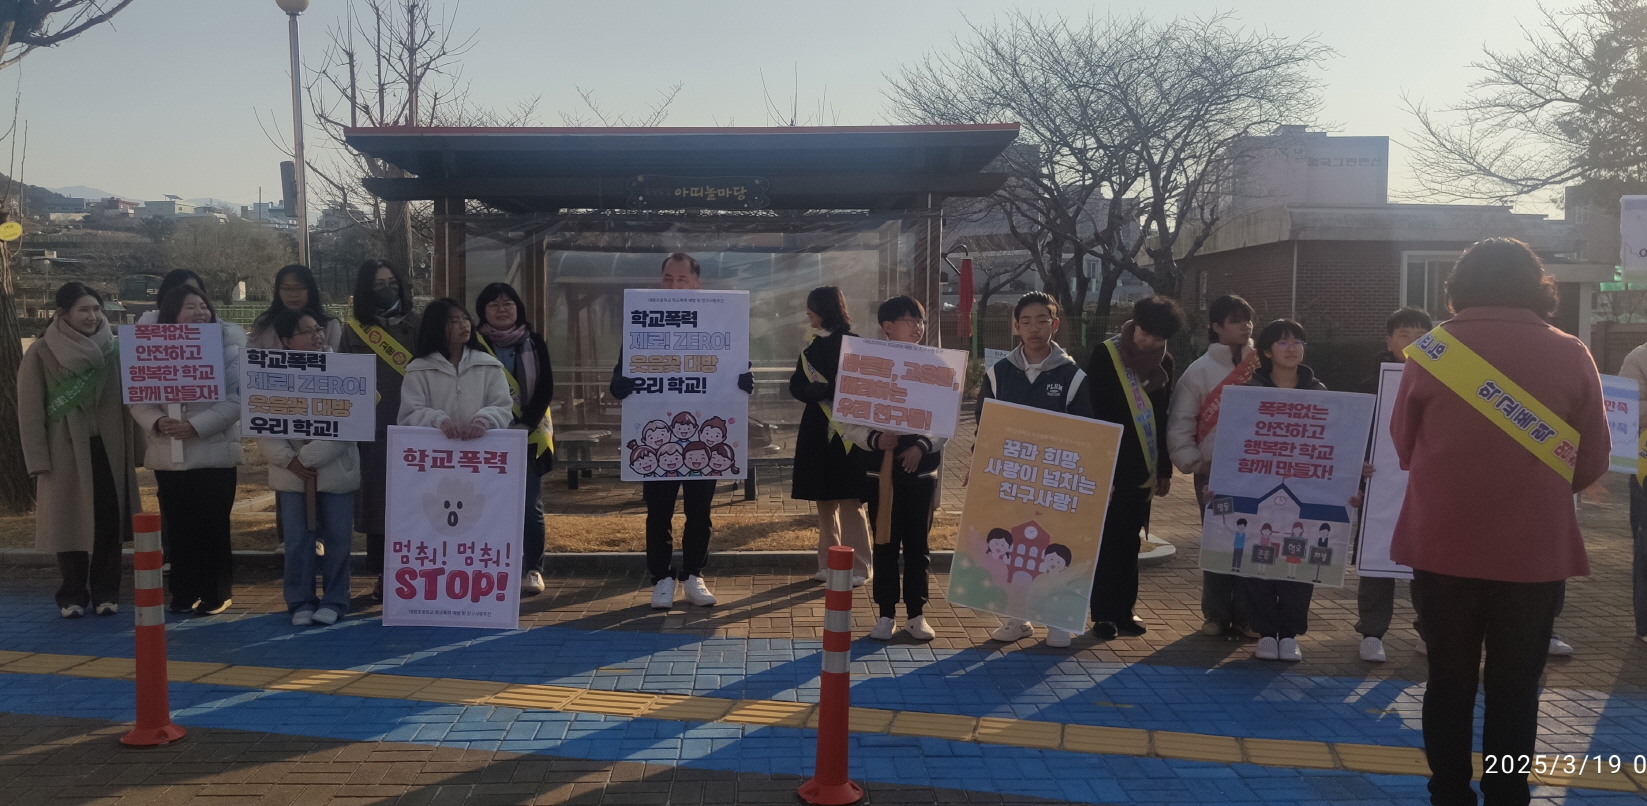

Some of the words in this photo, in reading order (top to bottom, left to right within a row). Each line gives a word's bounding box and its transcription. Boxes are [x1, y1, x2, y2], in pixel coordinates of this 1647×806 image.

[674, 184, 748, 201] 아띠놀마당
[630, 309, 698, 328] 학교폭력
[135, 324, 201, 342] 폭력없는
[629, 331, 671, 351] 제로!
[672, 331, 731, 351] ZERO!
[135, 344, 203, 362] 안전하고
[247, 349, 327, 371] 학교폭력
[629, 354, 682, 374] 웃음꽃
[683, 354, 719, 374] 대방
[128, 365, 179, 382] 행복한
[181, 364, 216, 382] 학교
[246, 371, 295, 391] 제로!
[298, 374, 367, 395] ZERO!
[901, 361, 959, 391] 고운말,
[128, 385, 161, 402] 함께
[163, 384, 219, 402] 만들자!
[631, 377, 663, 395] 우리
[666, 377, 707, 395] 학교!
[248, 395, 309, 416] 웃음꽃
[311, 398, 353, 418] 대방
[837, 398, 872, 420] 우리
[874, 403, 932, 430] 친구들!
[1258, 401, 1330, 421] 폭력없는
[1476, 379, 1556, 444] 학교폭력
[250, 417, 288, 435] 우리
[292, 418, 339, 438] 학교!
[1254, 420, 1325, 441] 안전하고
[403, 447, 508, 474] 학교폭력
[1002, 438, 1038, 462] 꿈과
[1042, 444, 1084, 473] 희망,
[1243, 439, 1297, 460] 행복한
[1299, 442, 1335, 461] 학교
[984, 456, 1037, 485] 사랑이
[1042, 467, 1096, 496] 넘치는
[1237, 457, 1273, 476] 함께
[1275, 460, 1334, 481] 만들자!
[998, 481, 1079, 514] 친구사랑!
[393, 540, 448, 567] 멈춰!
[457, 542, 511, 568] 멈춰!
[394, 566, 509, 603] STOP!
